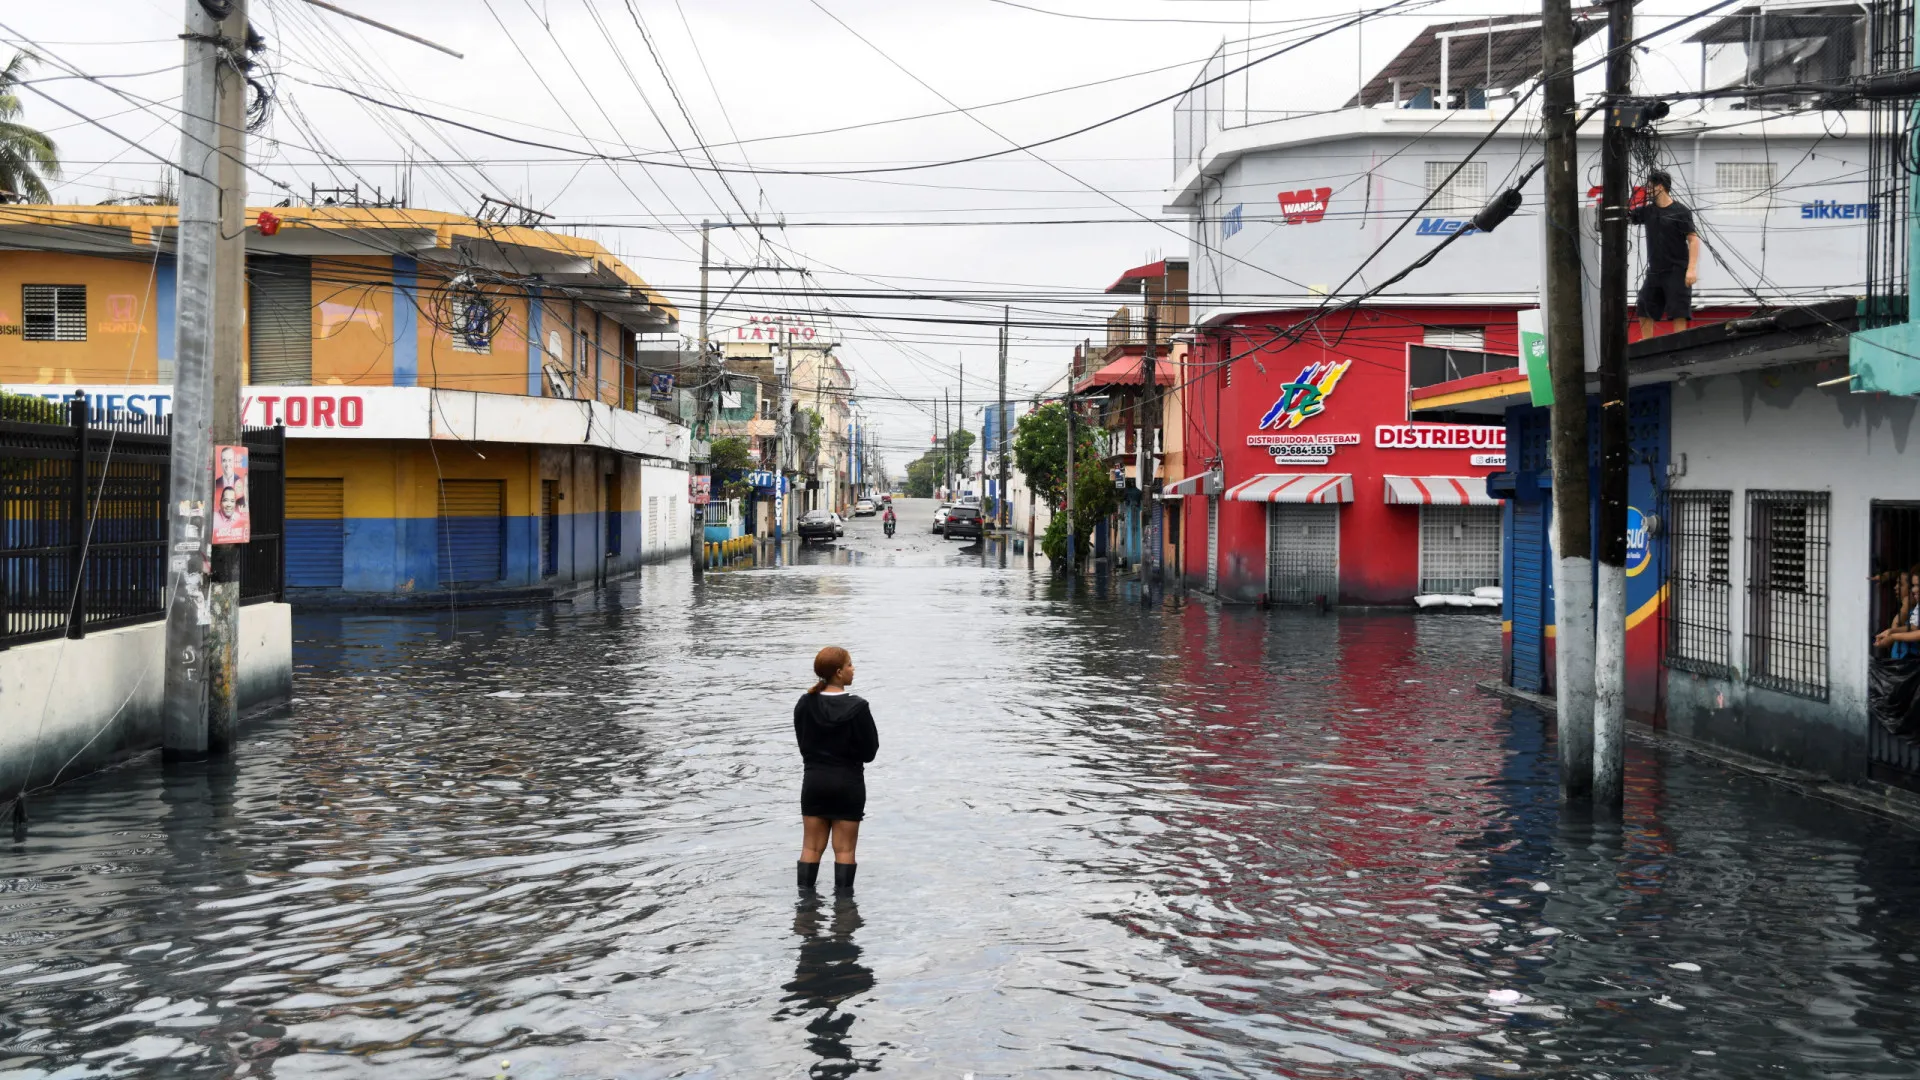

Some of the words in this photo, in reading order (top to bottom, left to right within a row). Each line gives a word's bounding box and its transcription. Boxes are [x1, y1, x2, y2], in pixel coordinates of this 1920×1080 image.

[1283, 202, 1324, 214] WANDA
[737, 327, 816, 340] LATNO
[258, 395, 364, 428] TORO
[1248, 436, 1315, 445] DISTRIBUIDORA
[1318, 435, 1357, 444] ESTEBAN
[1269, 446, 1334, 455] 809-684-5555
